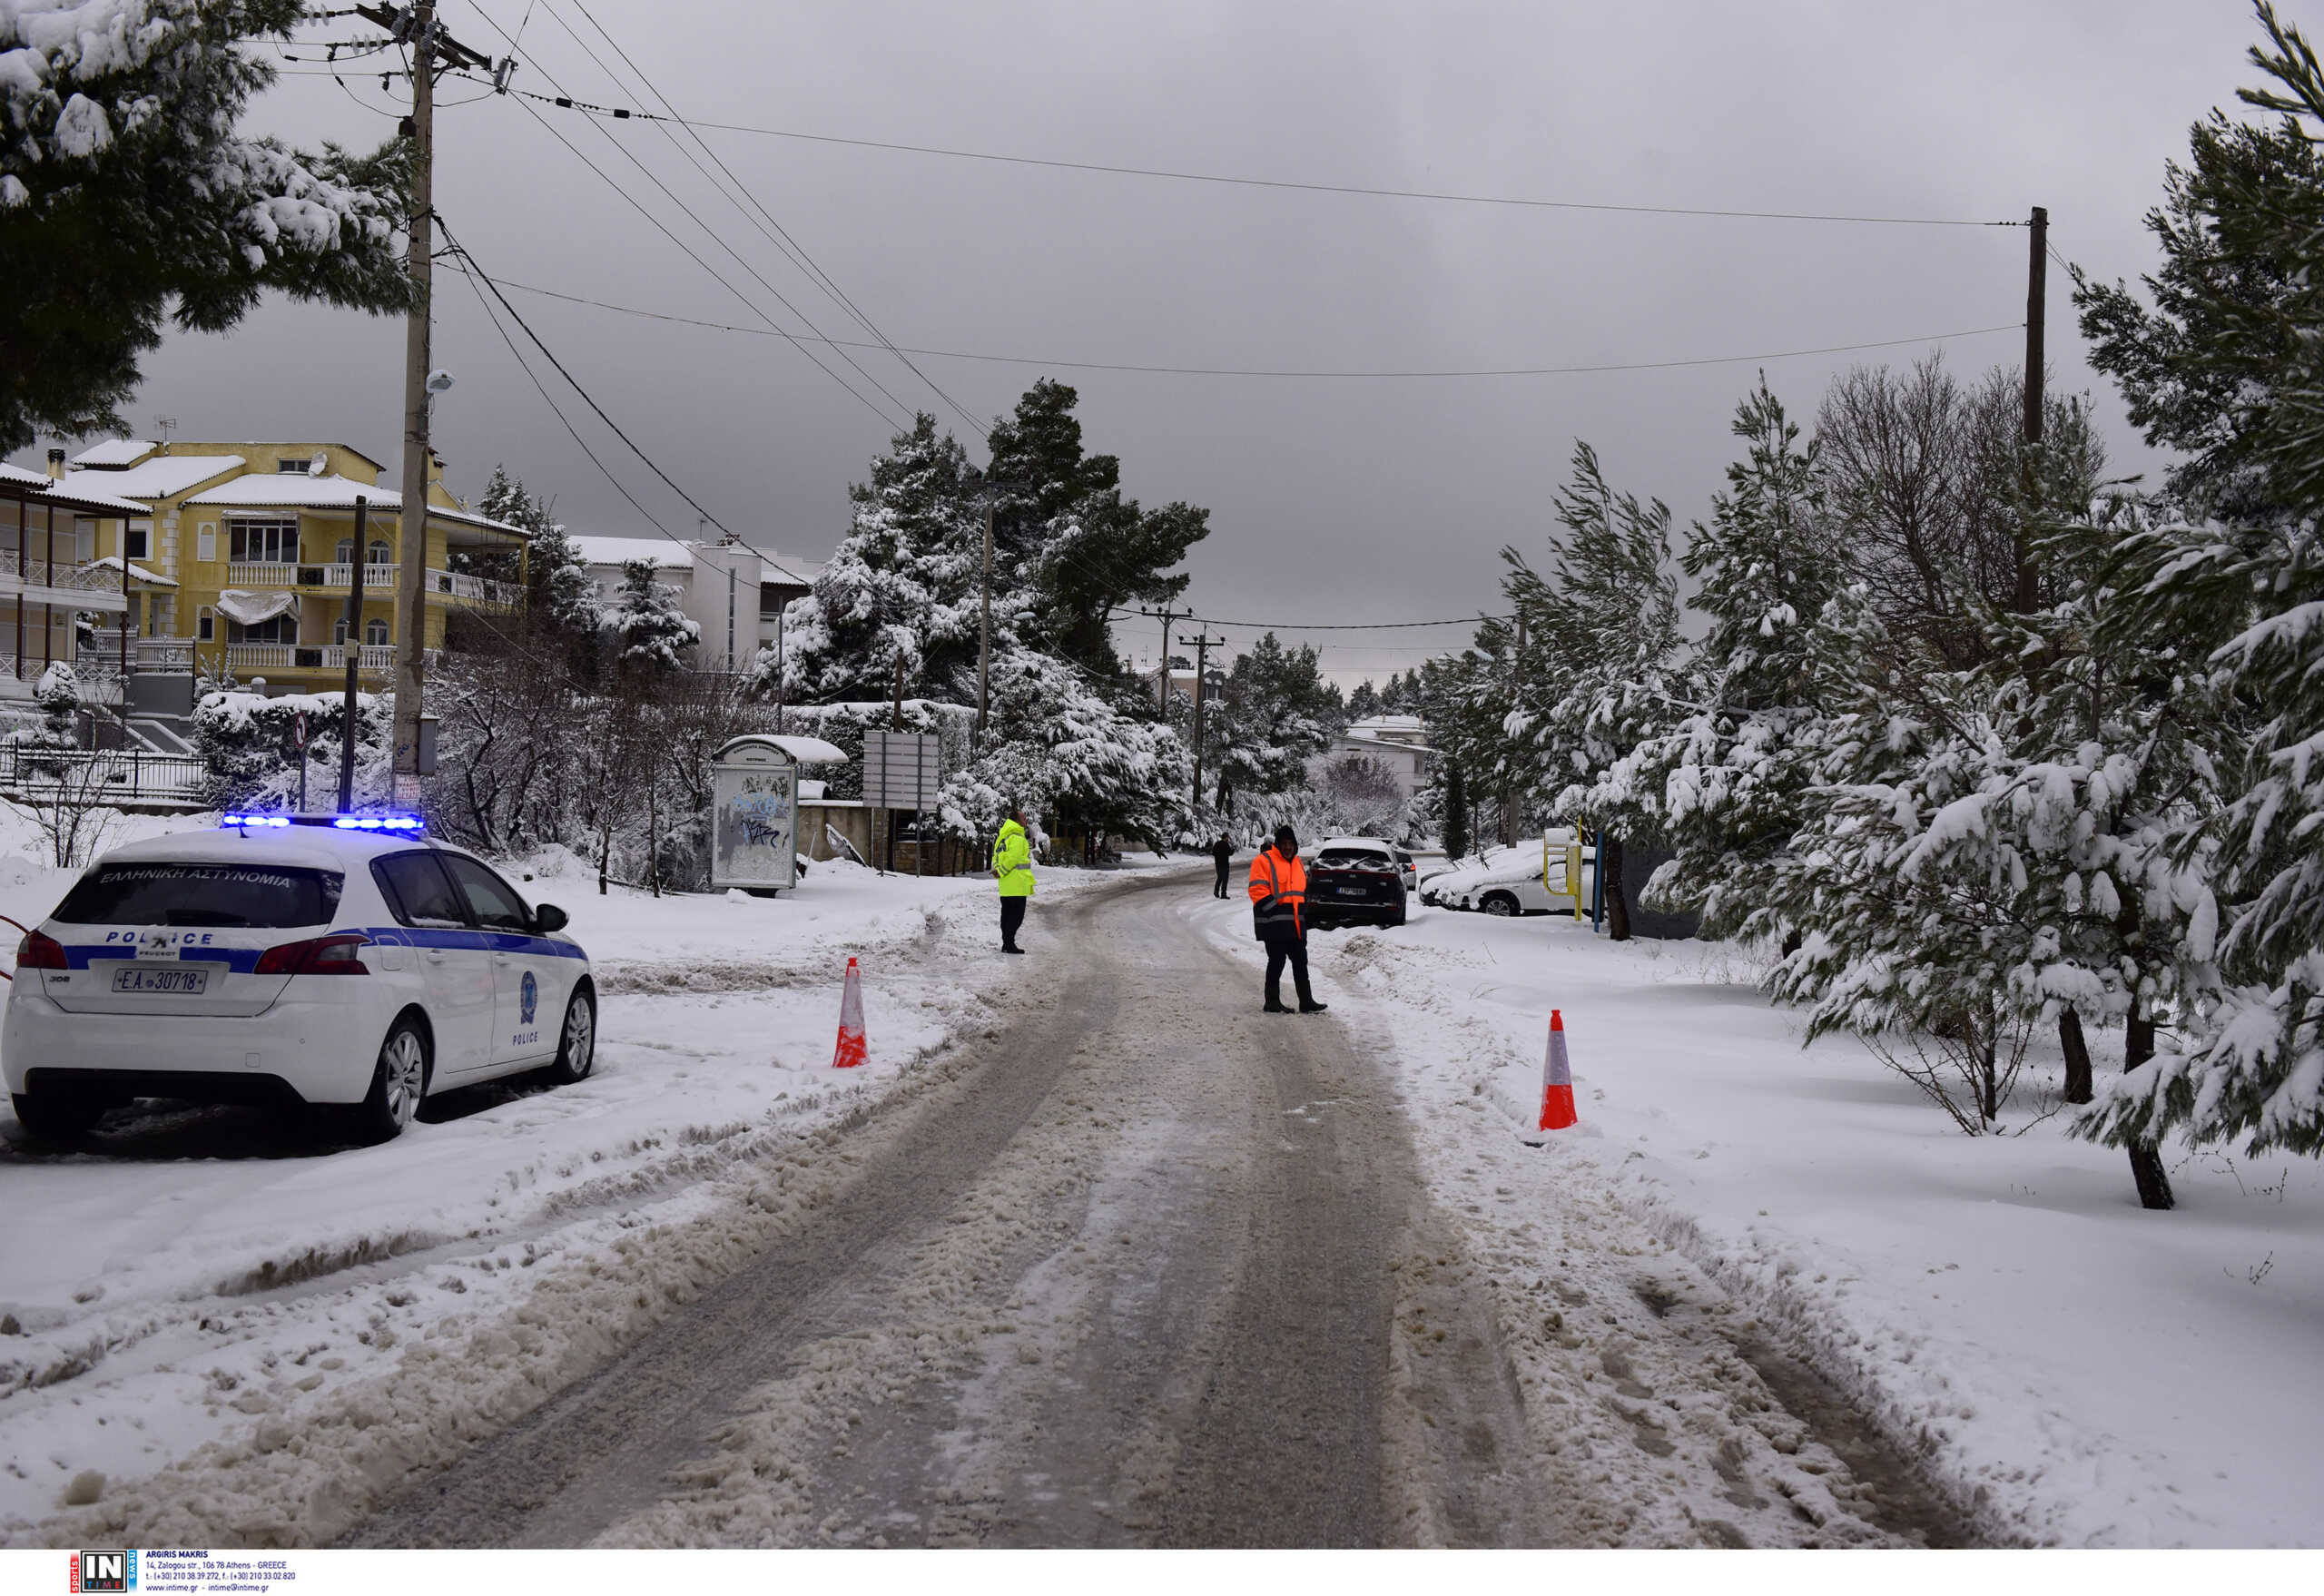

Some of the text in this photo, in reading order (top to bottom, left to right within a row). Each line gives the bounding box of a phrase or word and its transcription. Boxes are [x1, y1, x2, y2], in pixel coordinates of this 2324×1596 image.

[100, 867, 290, 889] ΕΛΛΗΝΙΚΗ ΑΣΤΥΝΟΜΙΑ
[105, 931, 214, 945] POLICE
[154, 973, 197, 990] 30718
[513, 1031, 538, 1046] POLICE
